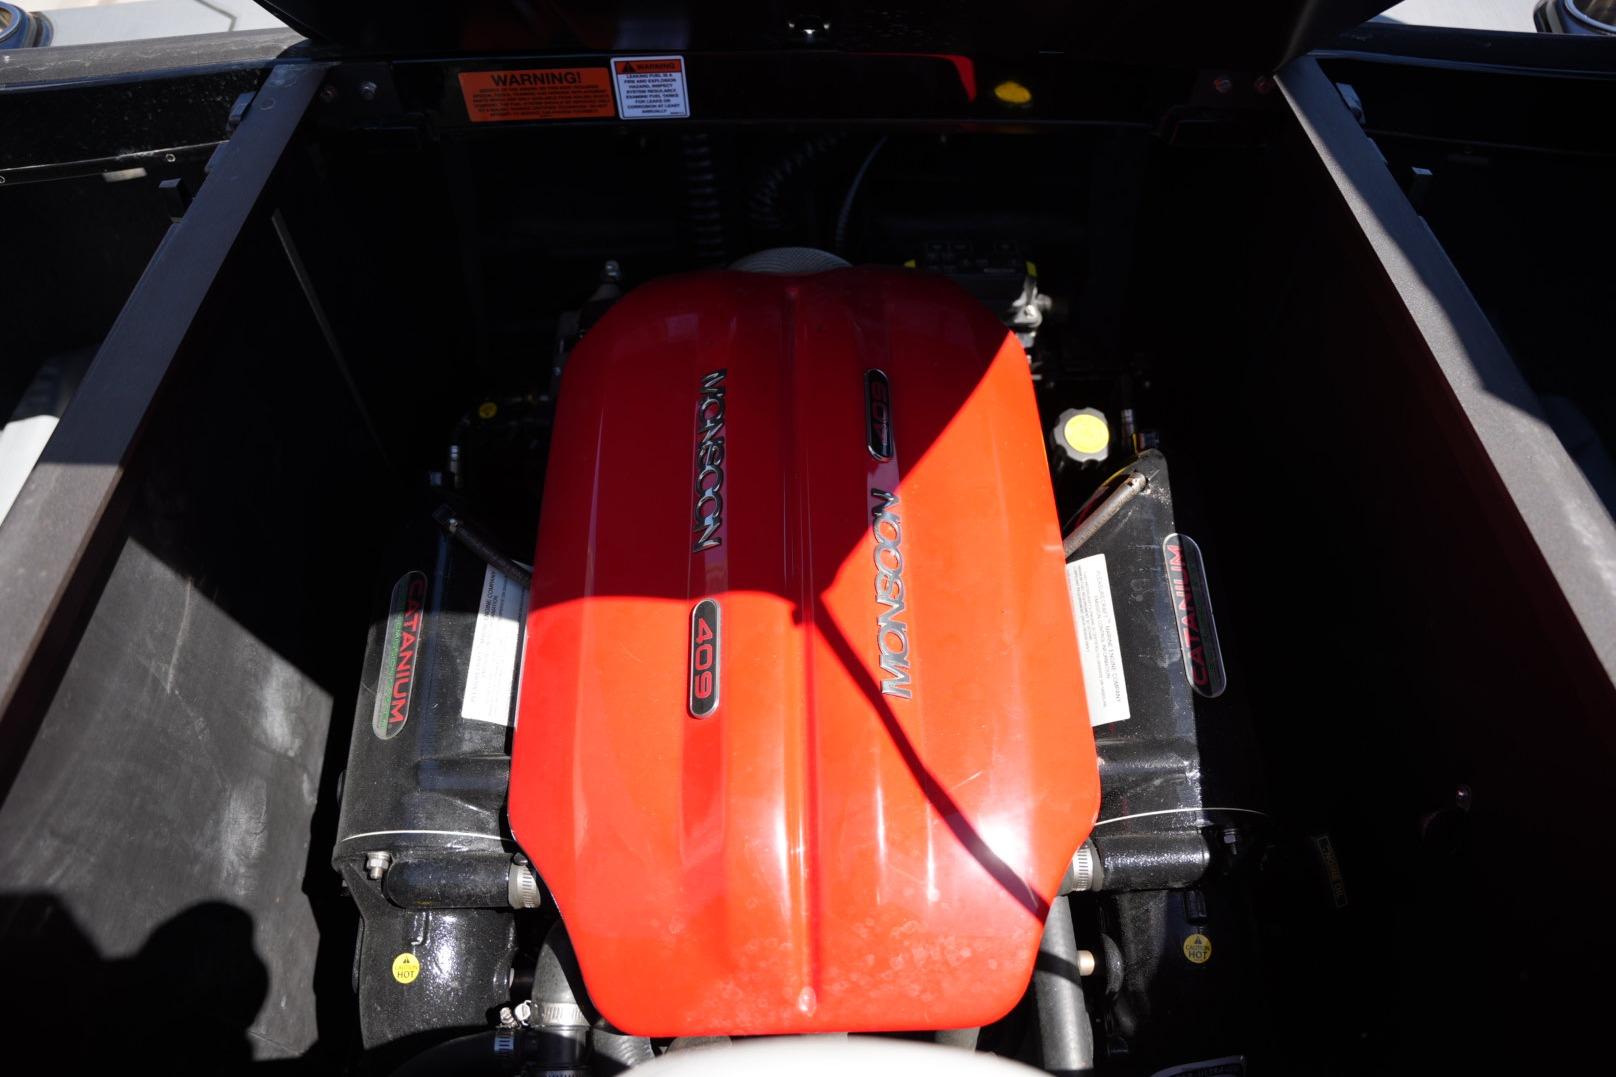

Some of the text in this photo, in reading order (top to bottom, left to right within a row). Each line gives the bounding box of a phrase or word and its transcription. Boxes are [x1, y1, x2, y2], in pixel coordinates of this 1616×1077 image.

[491, 71, 582, 86] WARNING!
[693, 368, 728, 553] MONSOON
[389, 578, 427, 724] CATANIUM
[694, 617, 713, 699] 409
[871, 488, 913, 700] MONSOON
[1167, 544, 1209, 686] CATANIUM
[1189, 951, 1207, 960] HOT
